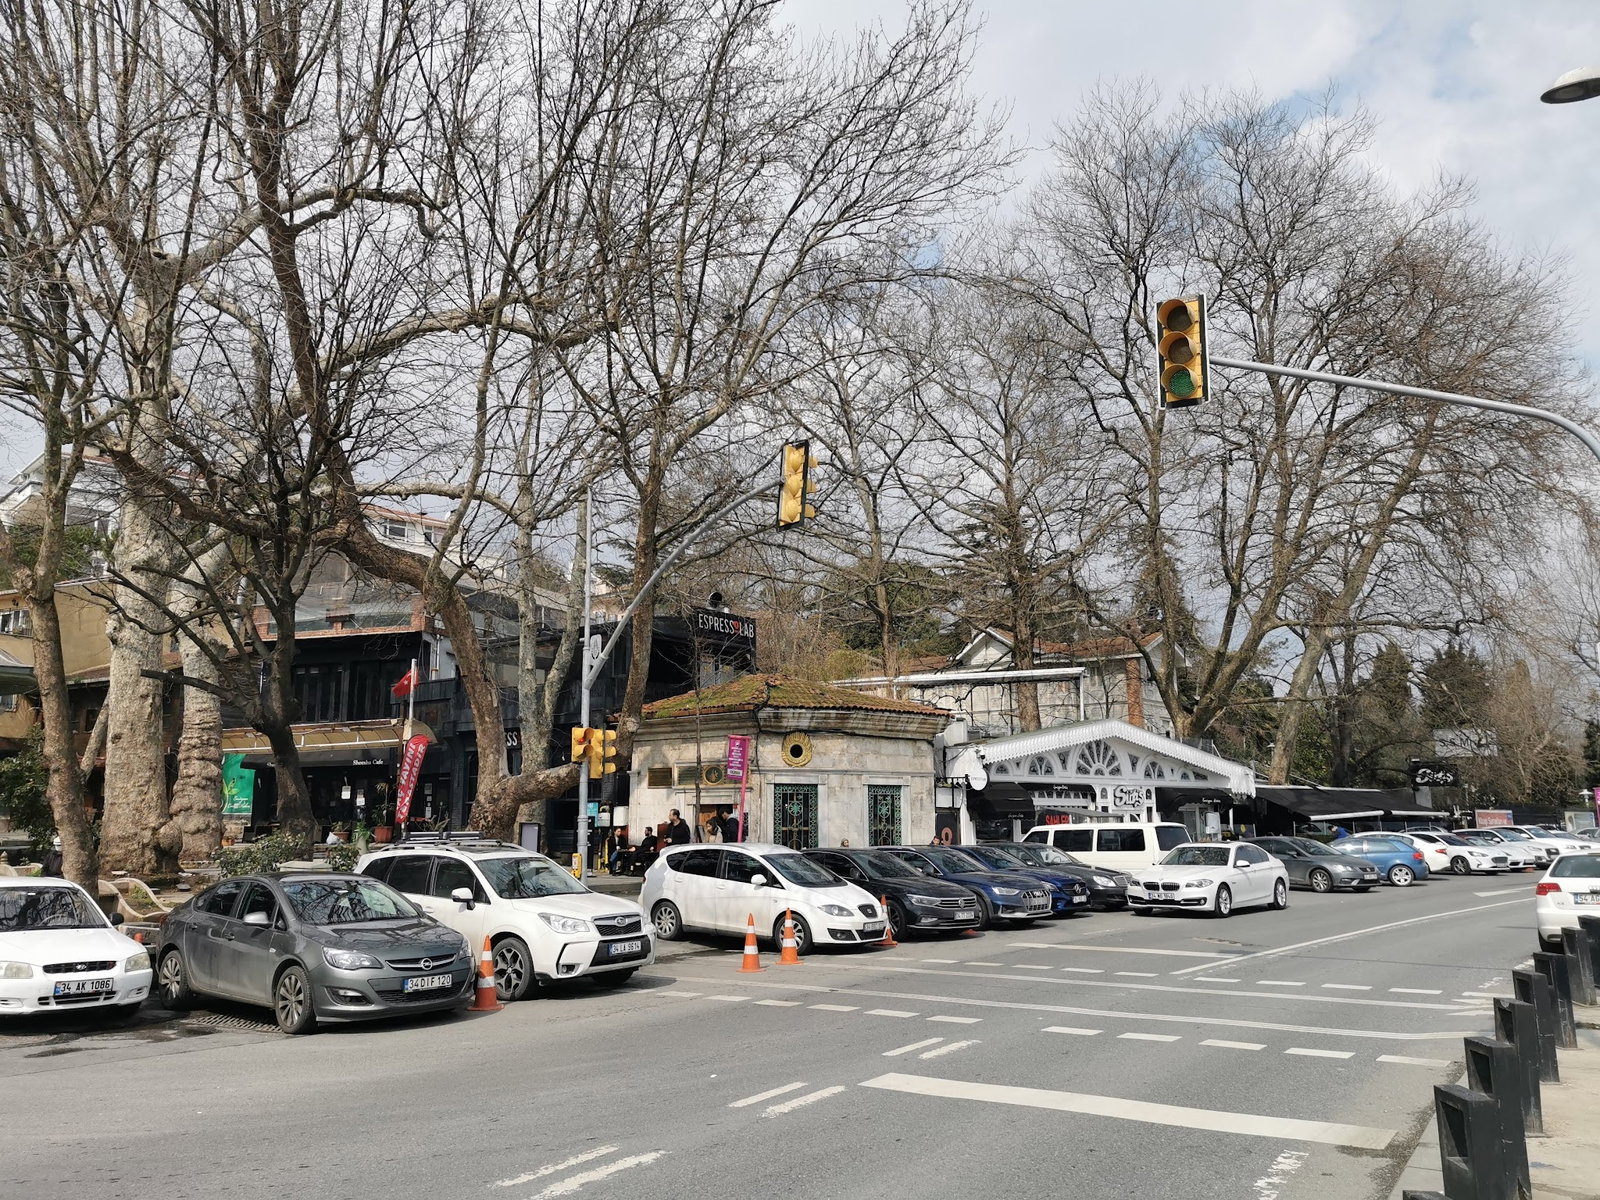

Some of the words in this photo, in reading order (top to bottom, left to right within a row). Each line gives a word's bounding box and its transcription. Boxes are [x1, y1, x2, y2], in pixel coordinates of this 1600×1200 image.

[61, 982, 71, 992] 34
[76, 981, 87, 991] AK
[91, 979, 111, 990] 1086
[437, 975, 451, 986] 120
